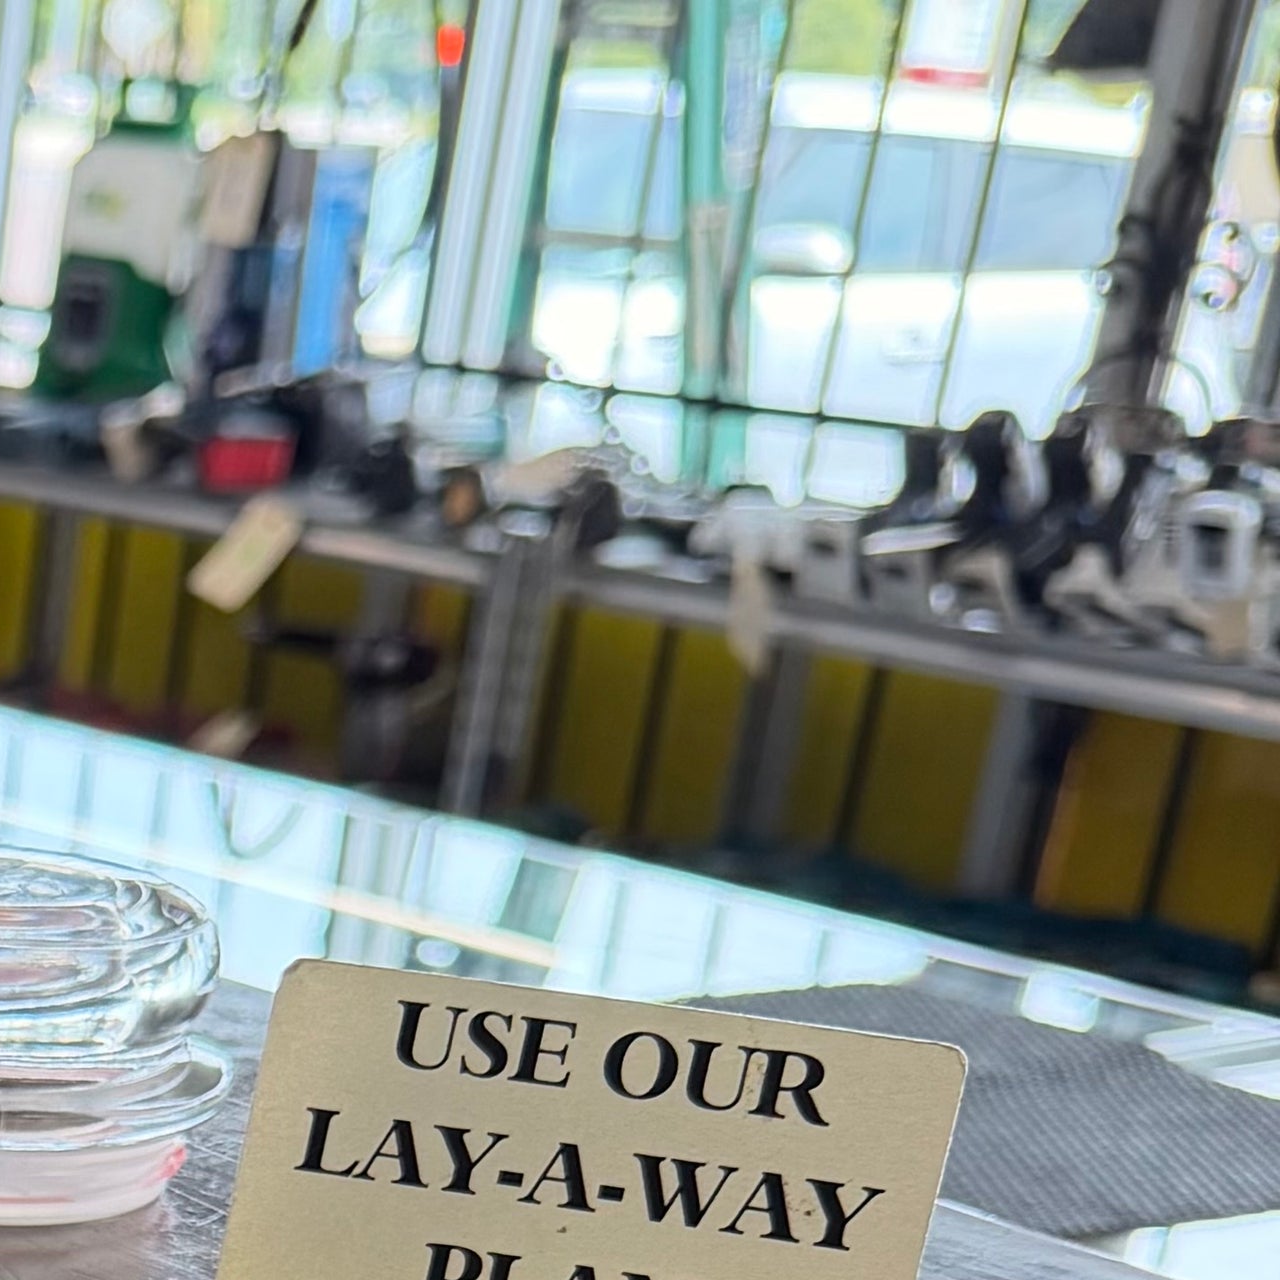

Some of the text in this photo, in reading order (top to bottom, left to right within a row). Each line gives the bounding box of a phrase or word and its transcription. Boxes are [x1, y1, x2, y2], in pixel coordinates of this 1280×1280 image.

[396, 1000, 829, 1127] USE OUR
[294, 1107, 885, 1251] LAY-A-WAY
